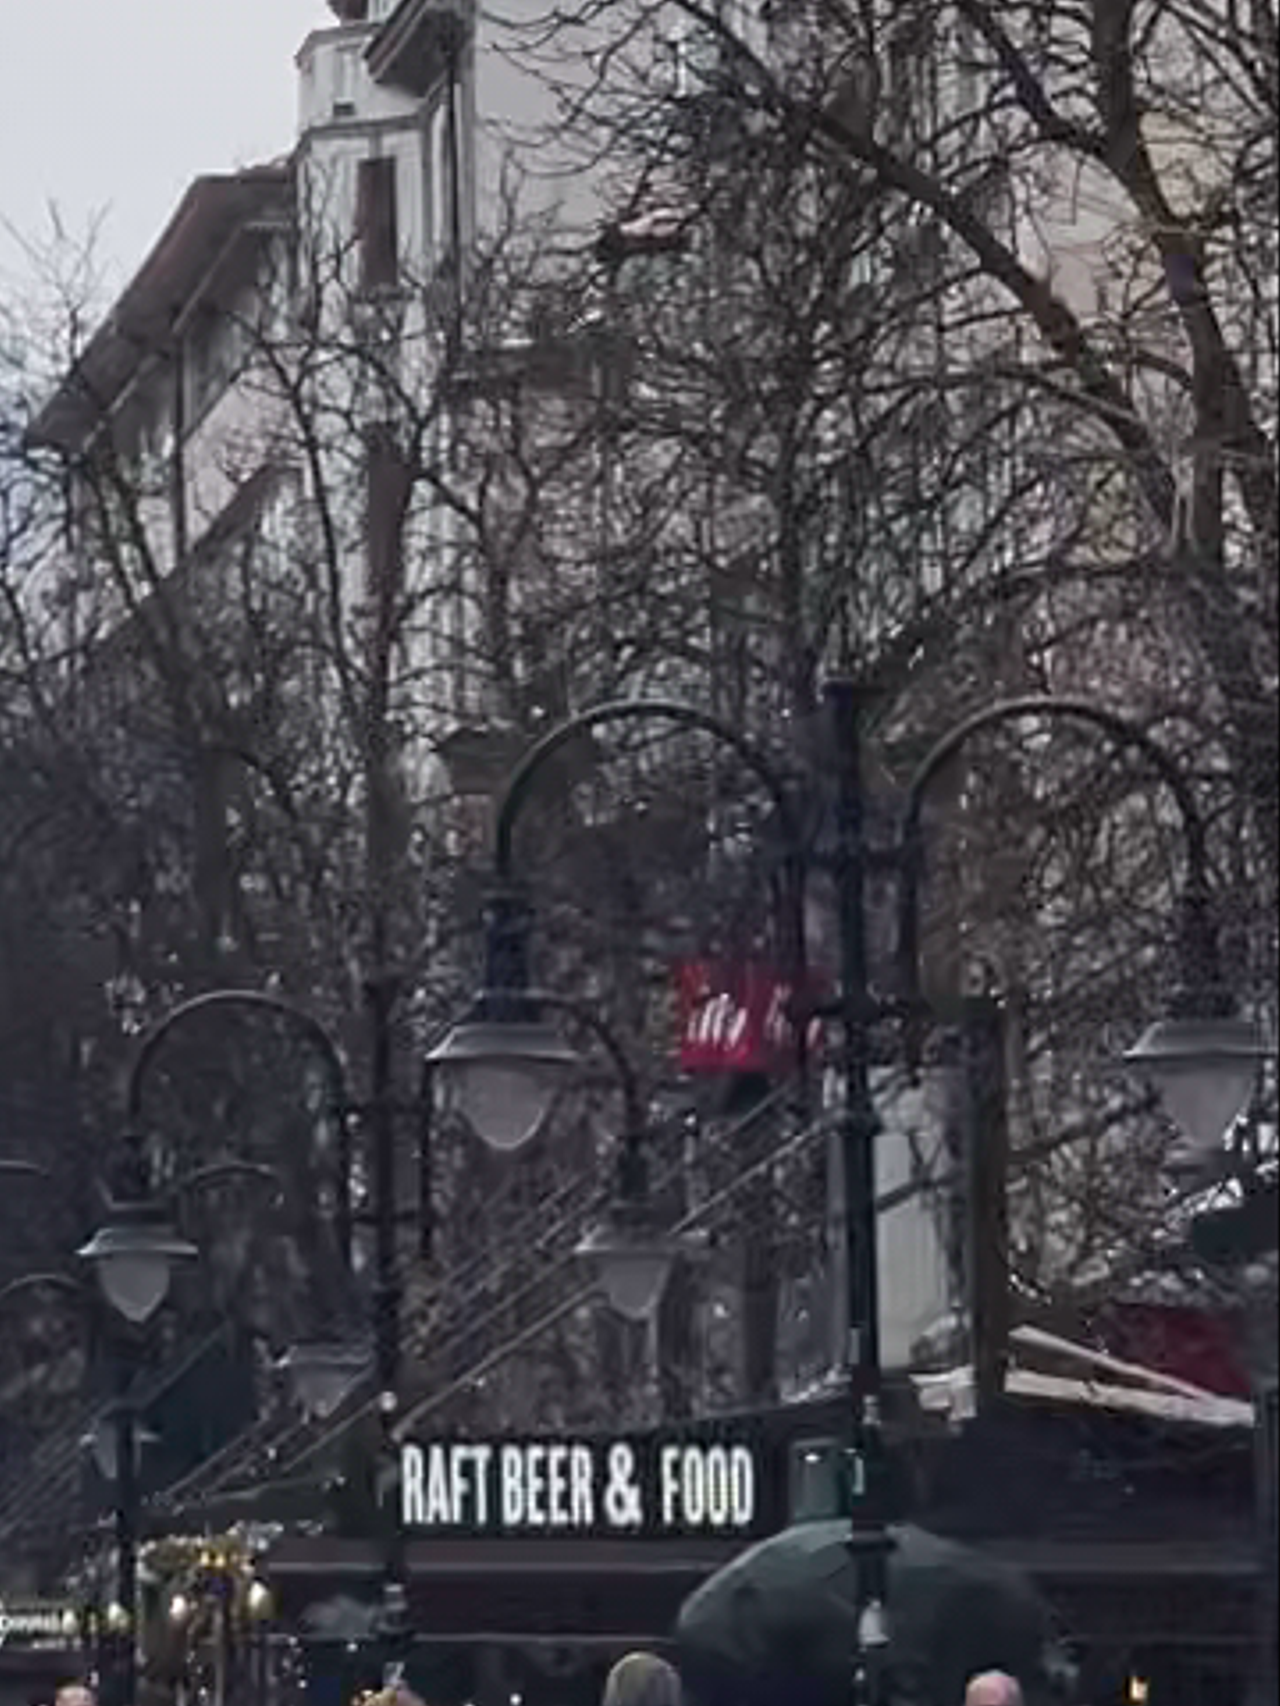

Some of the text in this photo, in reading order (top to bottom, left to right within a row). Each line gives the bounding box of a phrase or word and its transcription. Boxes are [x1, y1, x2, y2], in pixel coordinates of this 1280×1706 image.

[502, 1444, 593, 1525] BEER
[605, 1443, 643, 1525] &
[661, 1445, 754, 1525] FOOD
